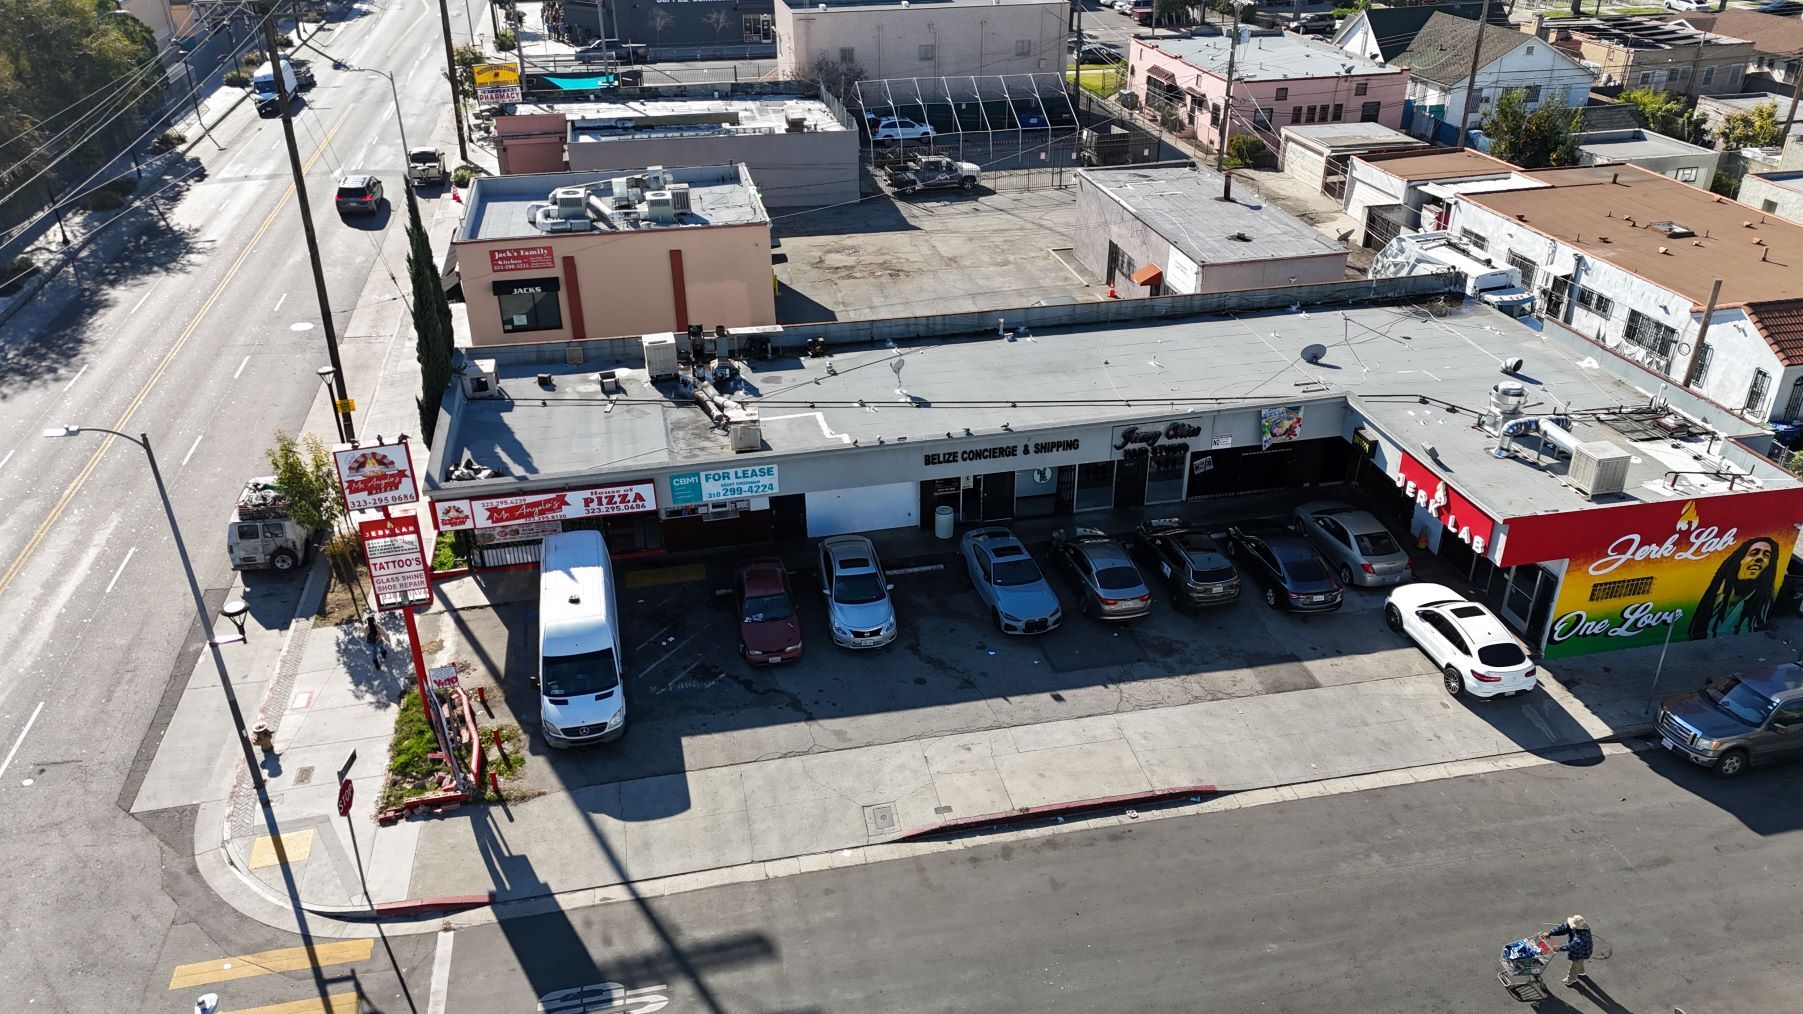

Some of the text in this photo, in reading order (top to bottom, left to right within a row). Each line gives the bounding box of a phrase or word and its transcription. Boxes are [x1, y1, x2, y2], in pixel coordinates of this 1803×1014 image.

[480, 92, 519, 101] PHARMACY
[495, 248, 548, 259] Jack's Family
[512, 286, 541, 295] JACKS
[924, 439, 1080, 466] BELIZE CONCIERGE & SHIPPING
[704, 467, 774, 482] FOR LEASE
[722, 483, 774, 496] 299-4224
[582, 492, 646, 507] PIZZA
[585, 503, 647, 514] 323.295.0686
[1396, 473, 1485, 554] JERK LAB
[365, 526, 415, 537] JERK LAB
[1588, 525, 1738, 576] Jerk Lab
[371, 557, 421, 571] TATTOO'S
[376, 572, 424, 585] GLASS SHINE
[377, 580, 425, 592] SHOE REPAIR
[1553, 601, 1684, 642] One Love
[338, 783, 353, 812] STOP
